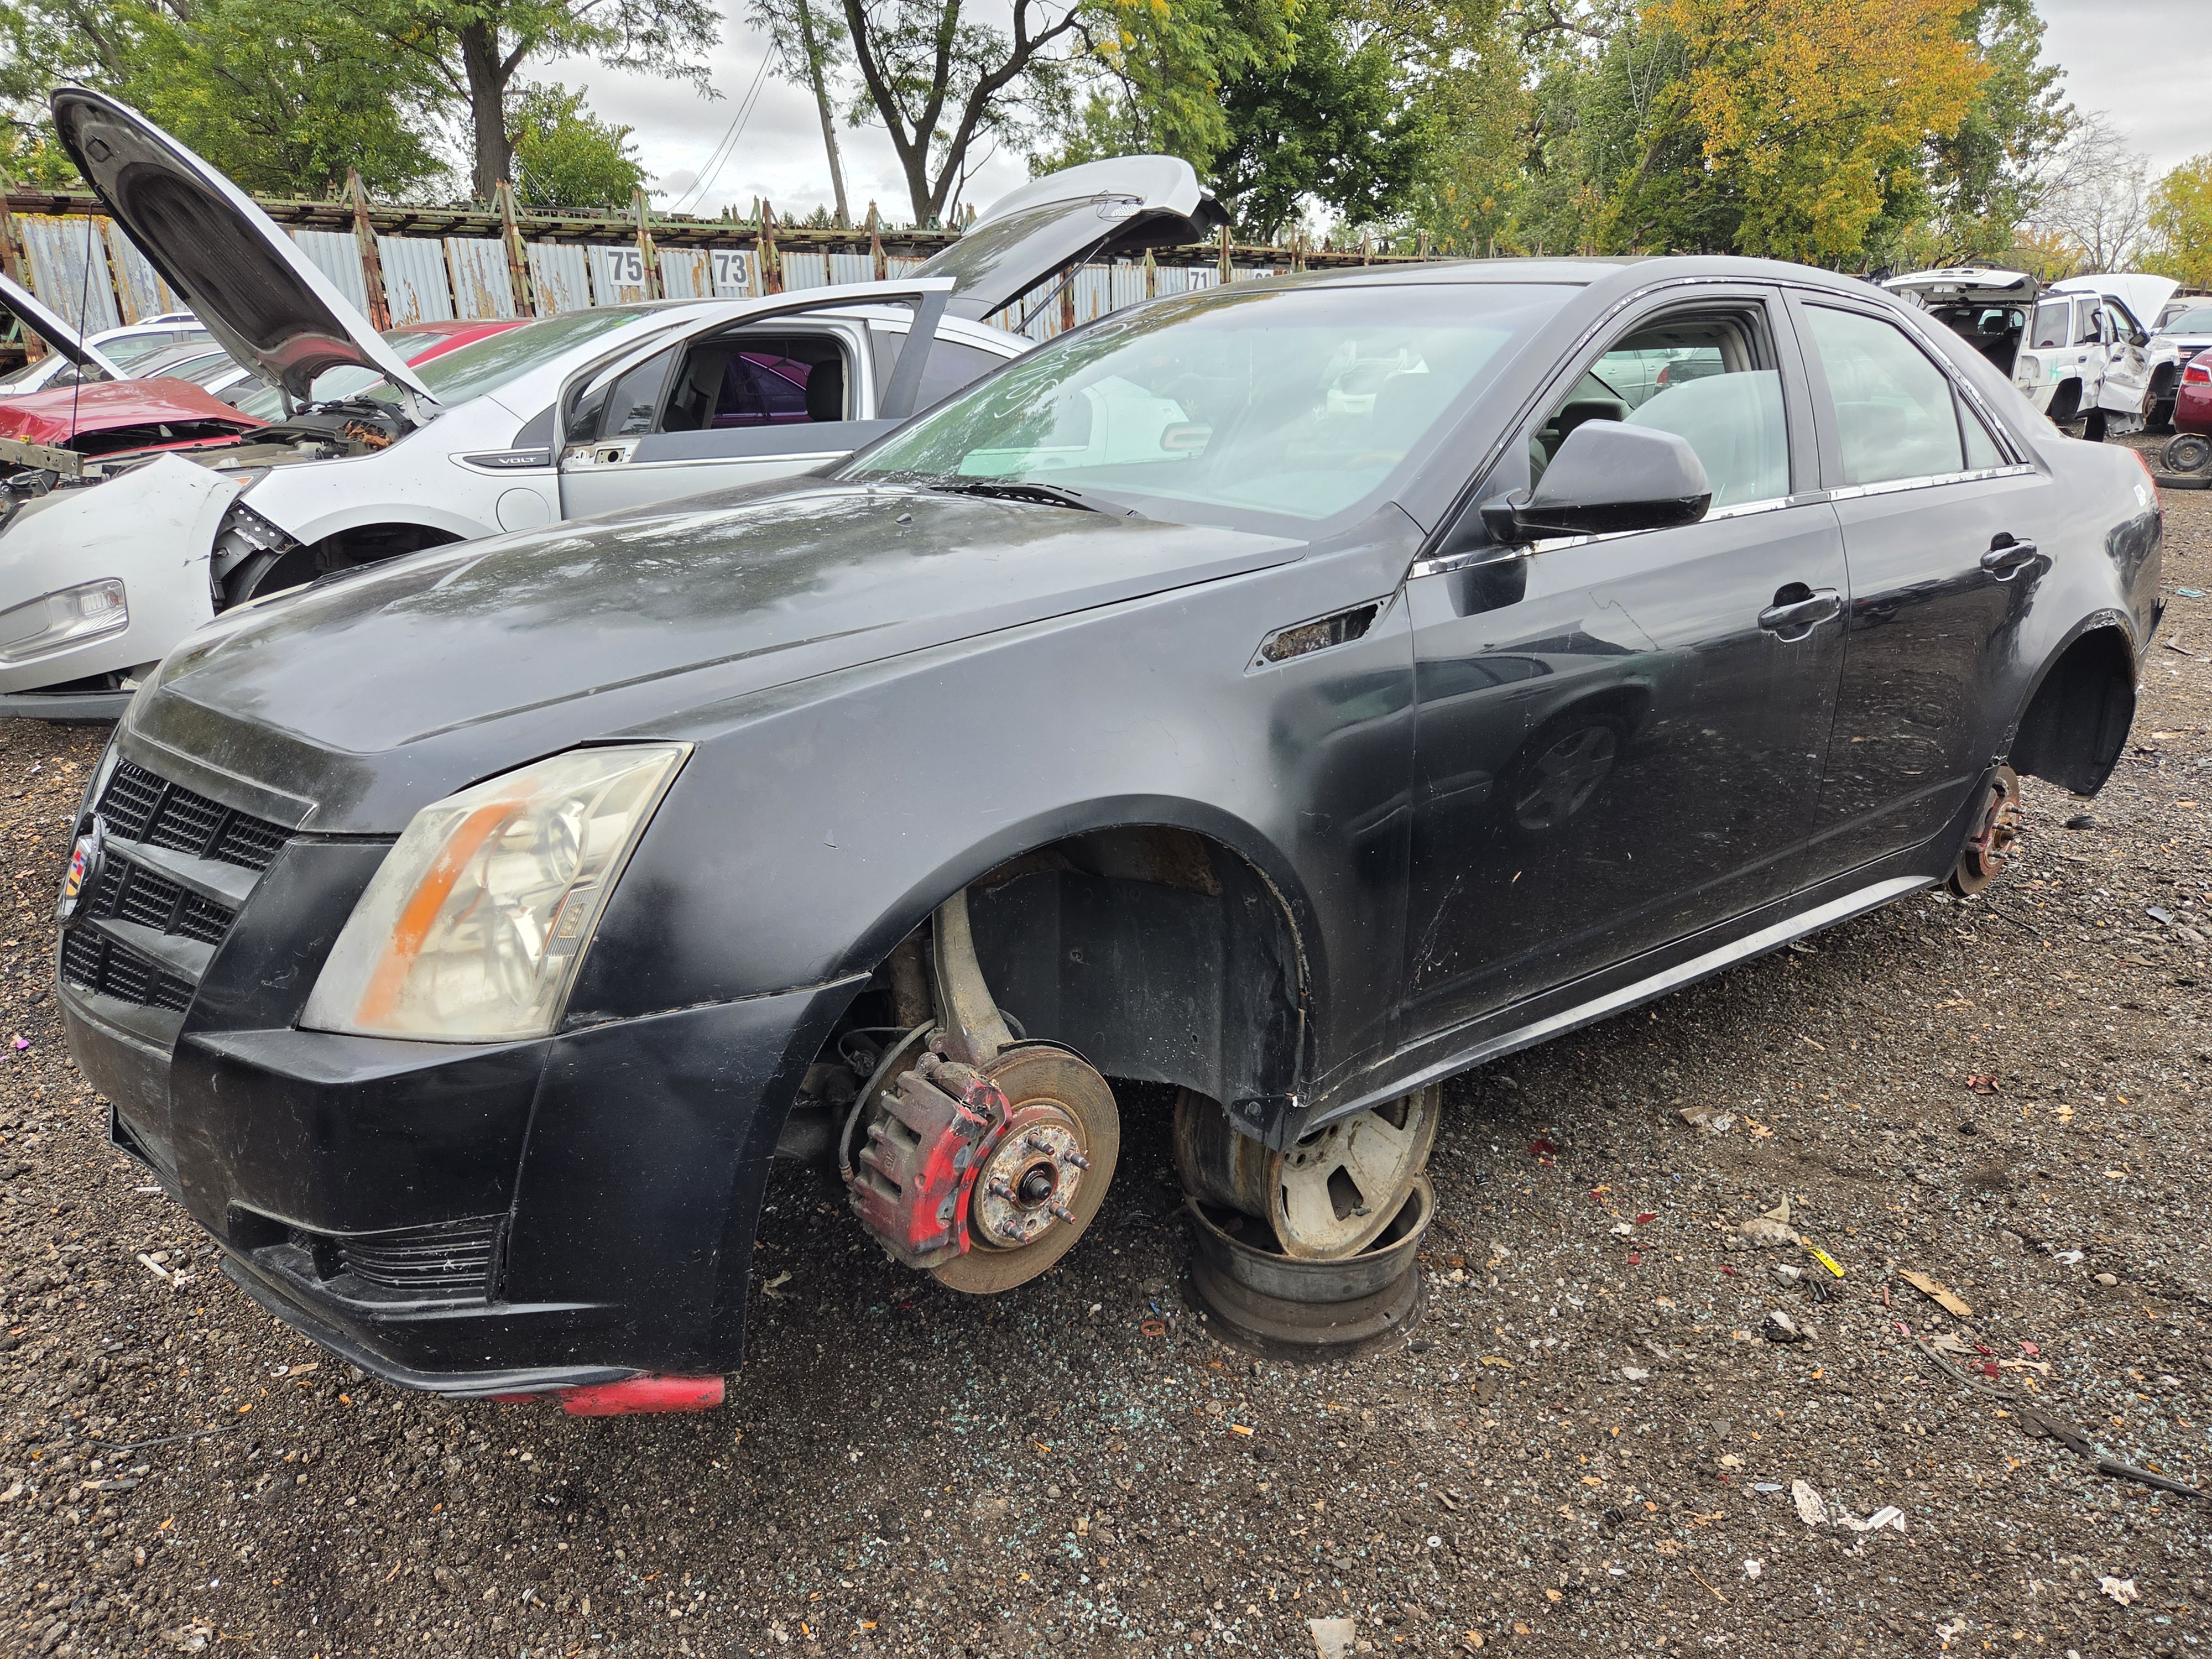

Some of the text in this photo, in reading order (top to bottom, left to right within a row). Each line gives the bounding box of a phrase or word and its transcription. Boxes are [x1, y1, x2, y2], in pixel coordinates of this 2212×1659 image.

[608, 251, 643, 281] 75
[714, 254, 747, 283] 73
[1190, 272, 1207, 289] 71
